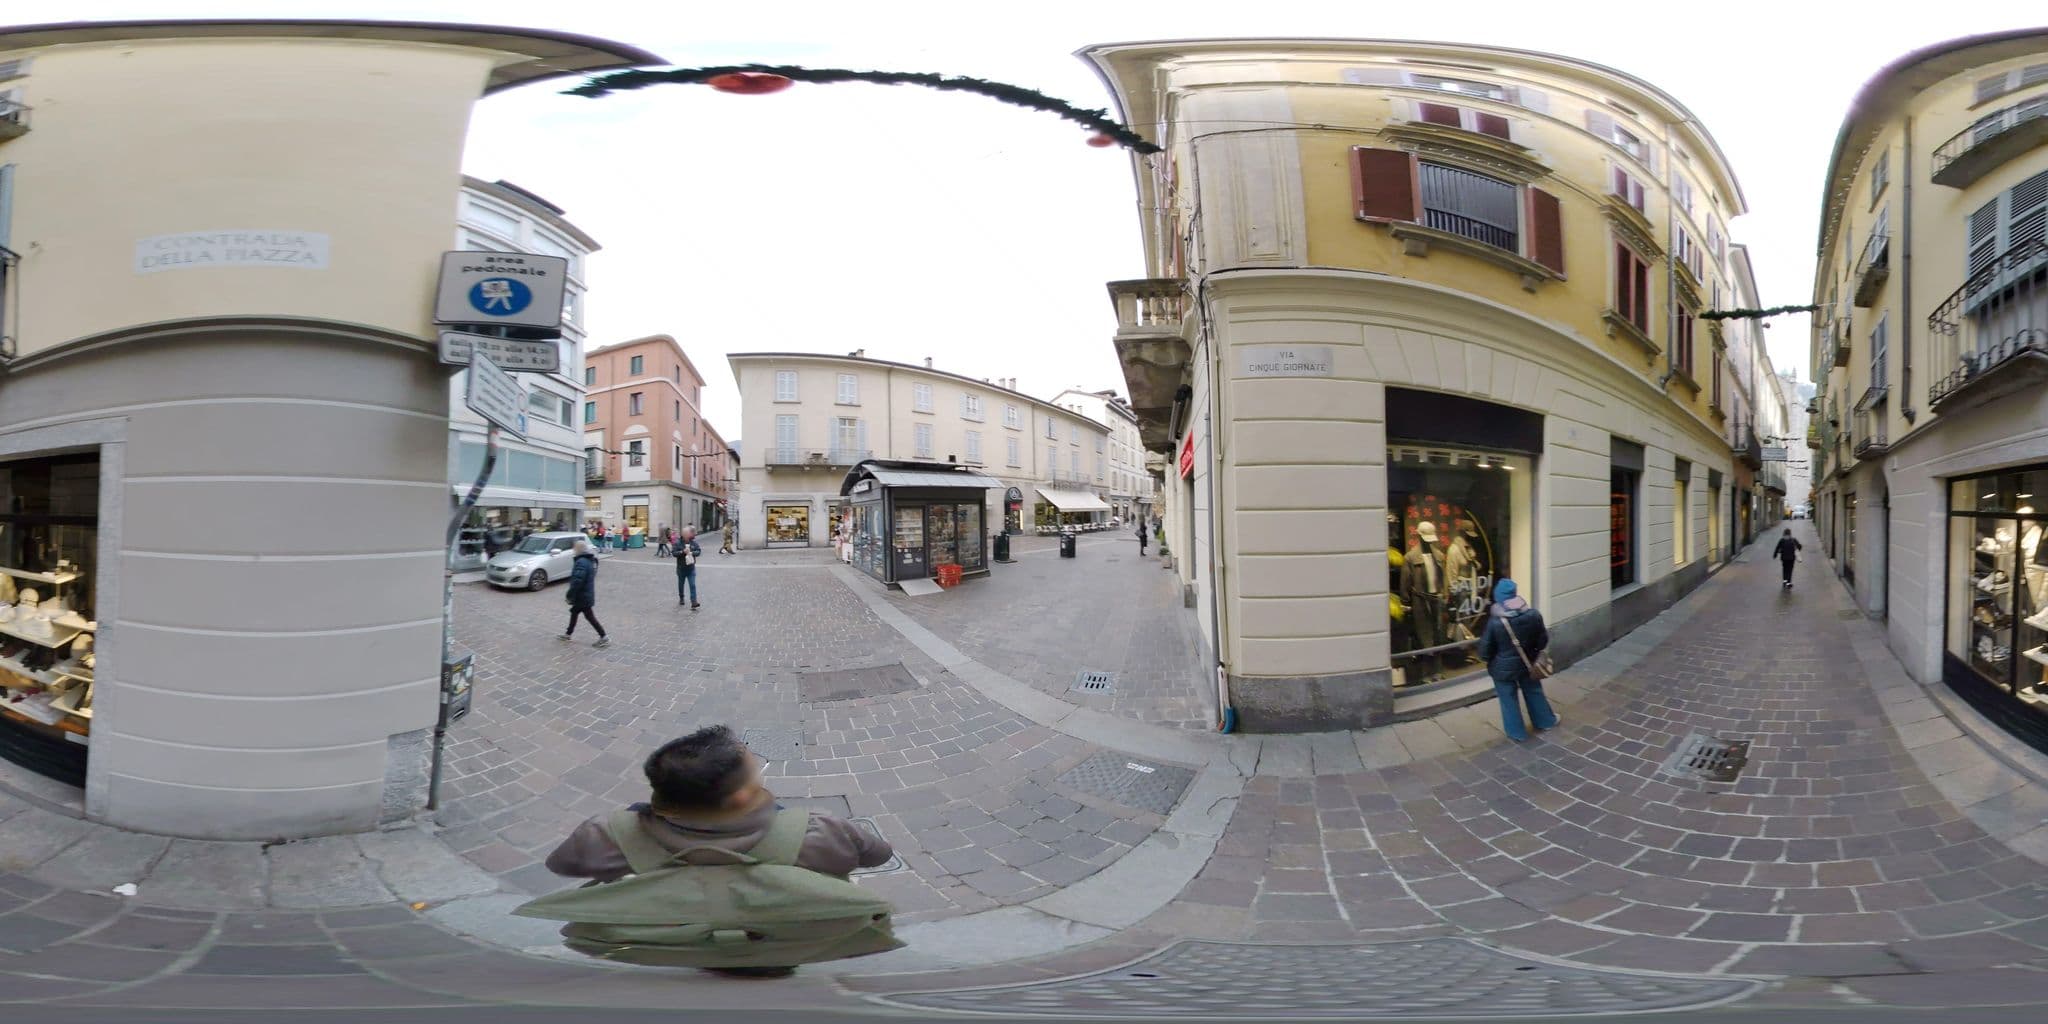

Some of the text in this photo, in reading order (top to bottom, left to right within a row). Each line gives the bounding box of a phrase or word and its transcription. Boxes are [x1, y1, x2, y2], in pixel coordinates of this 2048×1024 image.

[153, 233, 309, 251] CONTRADA
[142, 248, 318, 268] DELLA PIAZZA
[485, 256, 525, 264] area
[462, 265, 547, 276] pedonale
[1279, 351, 1295, 359] VIA
[1248, 363, 1327, 372] CINQUE GIORNATE
